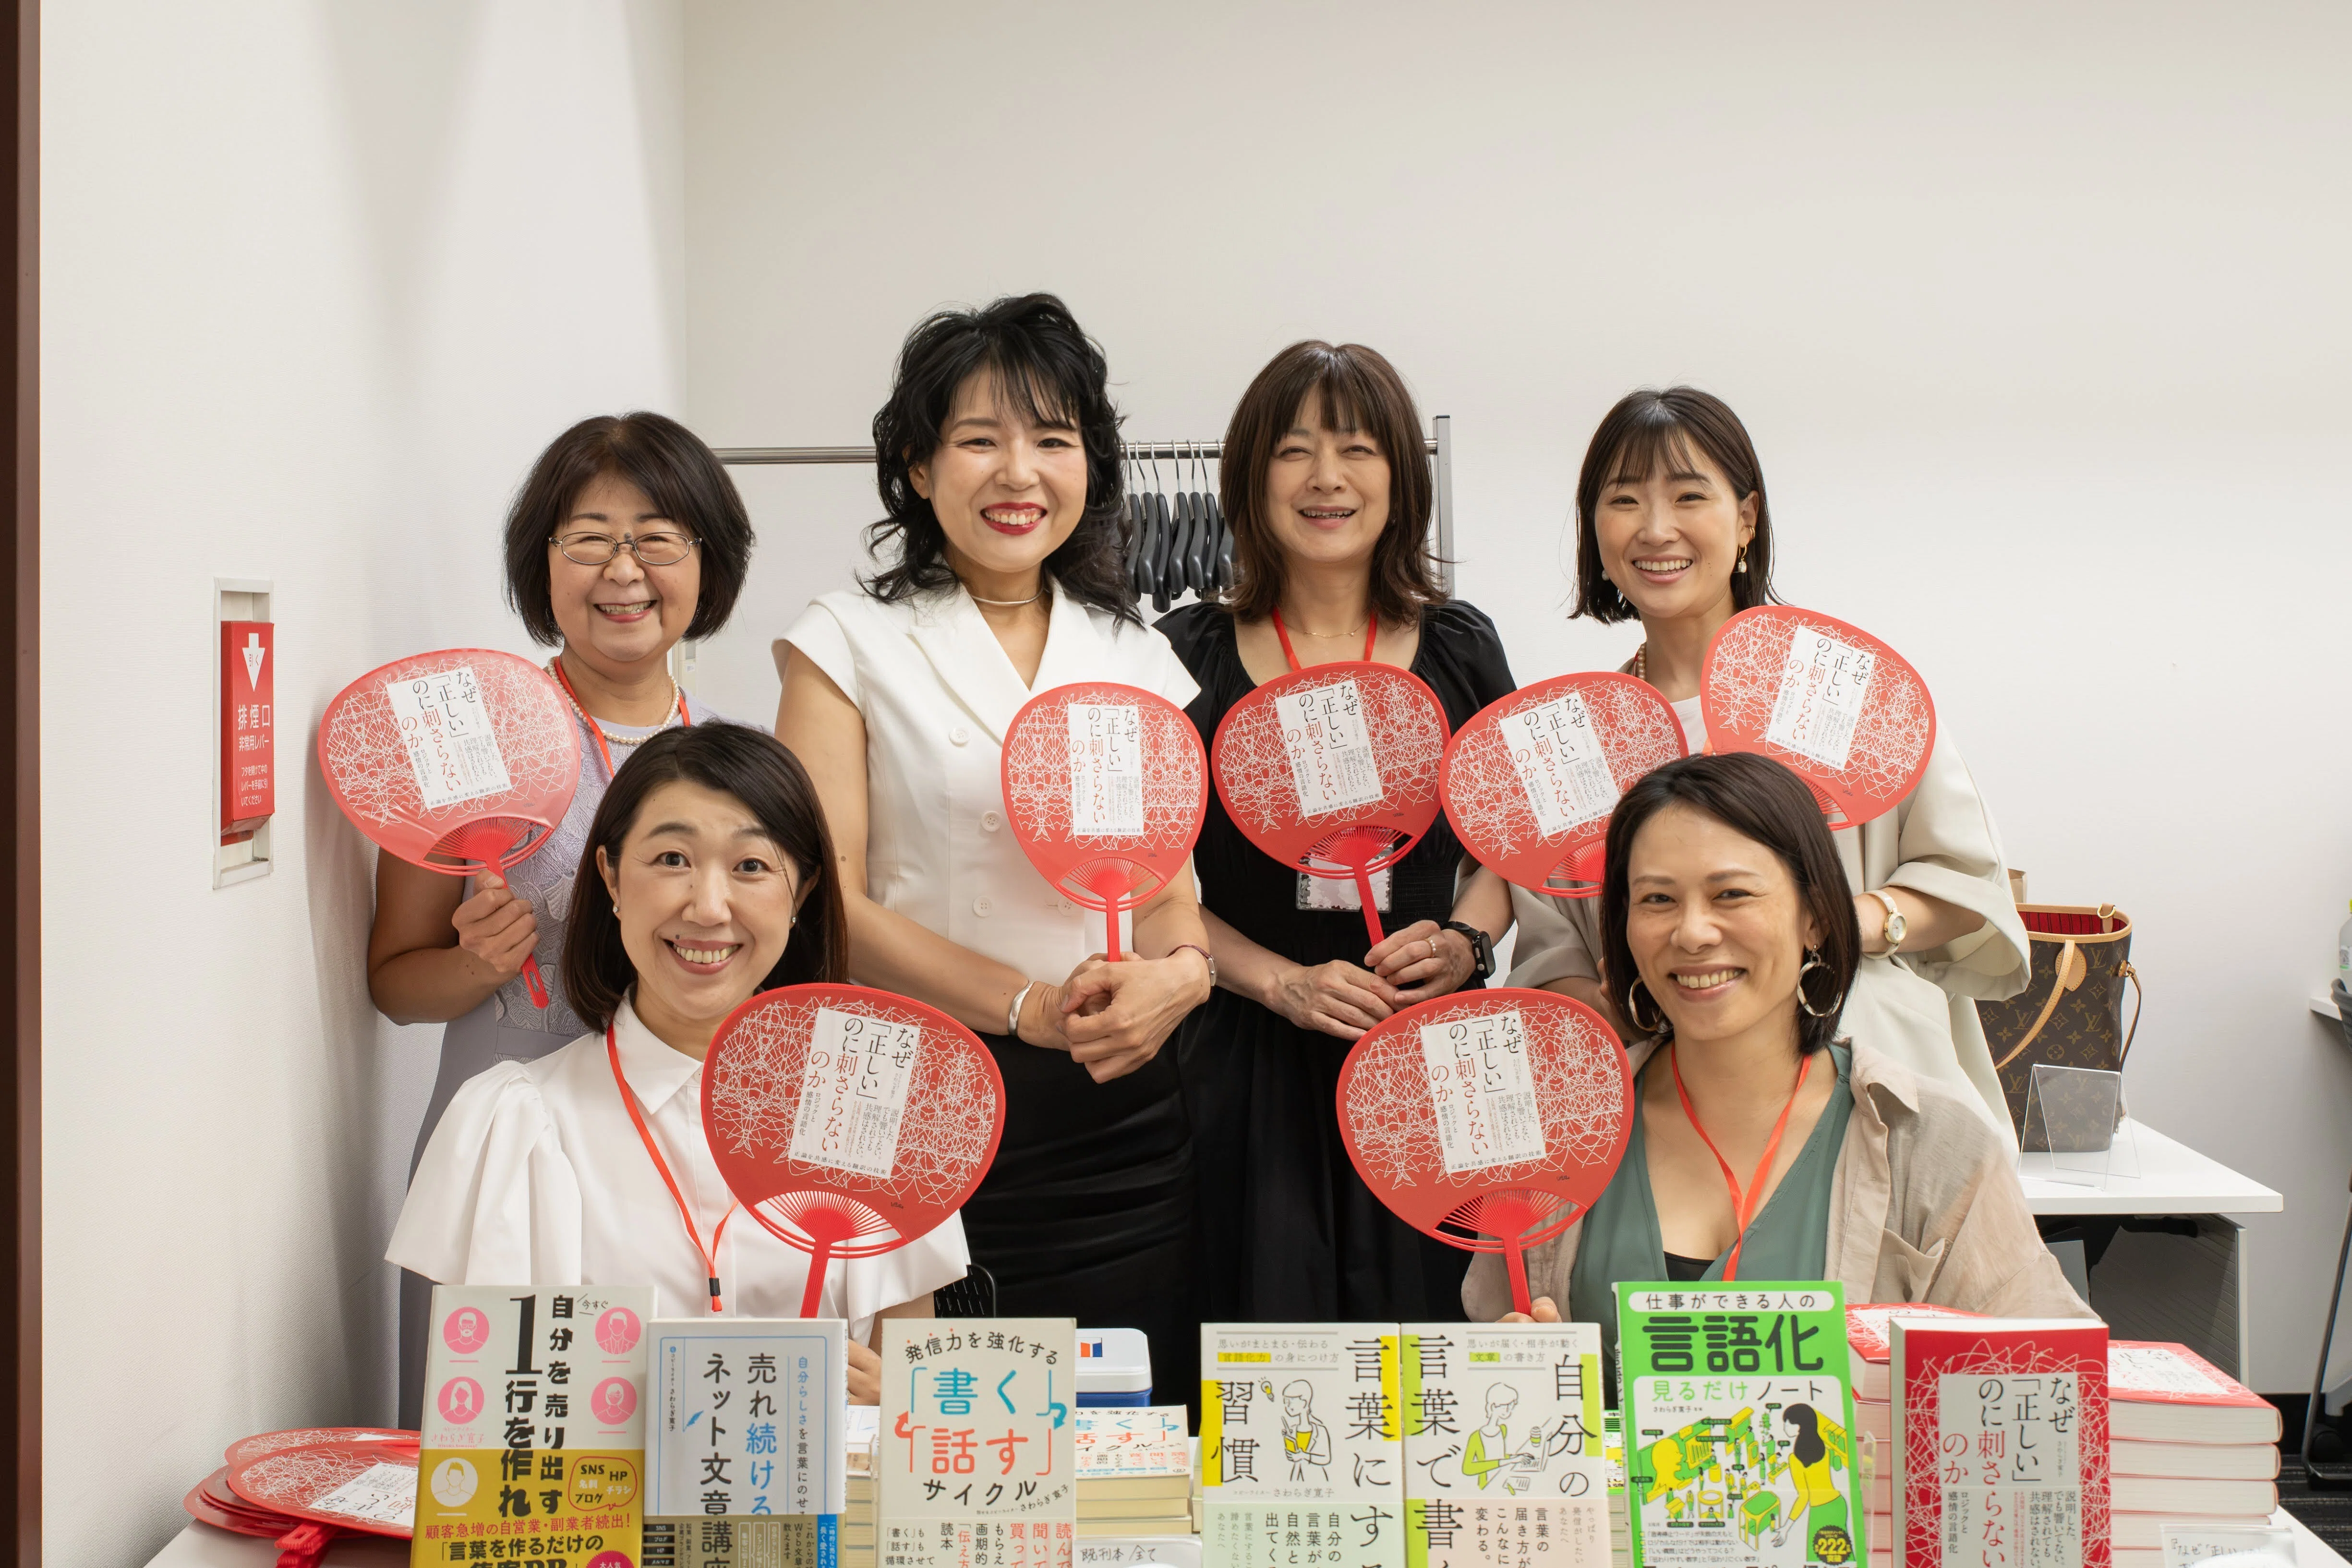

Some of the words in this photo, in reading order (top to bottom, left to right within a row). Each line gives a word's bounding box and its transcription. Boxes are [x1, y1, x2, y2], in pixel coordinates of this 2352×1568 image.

[250, 654, 258, 667] 引く
[1785, 659, 1804, 688] のか
[1822, 644, 1853, 706] 「正しい」
[1851, 654, 1870, 685] なぜ
[431, 675, 469, 737] 「正しい」
[456, 672, 476, 703] なぜ
[1340, 685, 1358, 716] なぜ
[1793, 639, 1832, 740] のに刺さらない
[238, 704, 270, 731] 排煙口
[402, 717, 423, 749] のか
[413, 680, 460, 791] のに刺さらない
[1124, 709, 1137, 742] なぜ
[1316, 688, 1348, 749] 「正しい」
[1541, 703, 1580, 764] 「正しい」
[1564, 699, 1585, 728] なぜ
[239, 734, 269, 752] 非常用レバー
[1072, 740, 1086, 772] のか
[1105, 709, 1122, 772] 「正しい」
[1287, 729, 1305, 760] のか
[1299, 694, 1336, 800] のに刺さらない
[241, 764, 267, 777] フタを開けて中の
[241, 778, 267, 792] レバーを手前に引
[1088, 708, 1105, 823] のに刺さらない
[1516, 749, 1536, 780] のか
[1524, 712, 1575, 817] のに刺さらない
[241, 795, 261, 807] いてください
[892, 1028, 915, 1069] なぜ
[1472, 1019, 1506, 1093] 「正しい」
[1501, 1016, 1522, 1054] なぜ
[807, 1051, 830, 1088] のか
[856, 1022, 892, 1099] 「正しい」
[822, 1018, 863, 1152] のに刺さらない
[1432, 1065, 1453, 1103] のか
[1450, 1024, 1488, 1155] のに刺さらない
[1646, 1293, 1814, 1310] 仕事ができる人の
[905, 1331, 1057, 1364] 発信力を強化する
[1642, 1314, 1823, 1372] 言語化
[498, 1294, 543, 1518] 1行を作れ
[539, 1295, 574, 1514] 自分を売り出す
[912, 1367, 1051, 1416] 「書く」
[1652, 1380, 1823, 1402] 見るだけノート
[2048, 1377, 2074, 1434] なぜ
[746, 1352, 778, 1515] 売れ続ける
[796, 1357, 809, 1515] 自分らしさを言葉にのせ
[1211, 1381, 1260, 1483] 習慣
[1547, 1354, 1598, 1496] 自分の
[2011, 1378, 2041, 1482] 「正しい」
[581, 1465, 604, 1474] SNS
[911, 1426, 1051, 1476] 「話す」
[1346, 1338, 1395, 1568] 言葉にす
[1410, 1335, 1464, 1568] 言葉で書
[1943, 1433, 1968, 1484] のか
[1977, 1378, 2005, 1568] のに刺さらない
[576, 1493, 603, 1503] ブログ
[607, 1486, 631, 1495] チラシ
[610, 1472, 627, 1481] HP
[923, 1480, 1037, 1506] サイクル
[886, 1528, 924, 1538] 「書く」も
[1476, 1507, 1491, 1560] 変わる。
[1535, 1508, 1549, 1552] 言葉の
[1948, 1492, 1958, 1554] 感情の言語化
[1961, 1492, 1969, 1533] ロジックと
[2041, 1492, 2053, 1557] 理解されても
[2065, 1491, 2077, 1541] 説明した。
[442, 1534, 604, 1561] 「言葉を作るだけの
[794, 1523, 803, 1568] Web文章
[806, 1523, 815, 1568] これからの
[886, 1542, 924, 1552] 「話す」も
[941, 1522, 953, 1550] 読本
[975, 1523, 988, 1565] 画期的
[995, 1523, 1004, 1565] もらえ
[1080, 1547, 1124, 1563] 既刊本
[1129, 1544, 1156, 1561] 全て
[1266, 1512, 1279, 1568] 出てく
[1286, 1512, 1301, 1564] 自然と
[1306, 1512, 1322, 1568] 言葉が
[1328, 1512, 1342, 1562] 自分の
[1497, 1508, 1509, 1564] こんなに
[1515, 1508, 1531, 1568] 届き方が
[1818, 1538, 1847, 1555] 222
[885, 1556, 935, 1565] 循環させて
